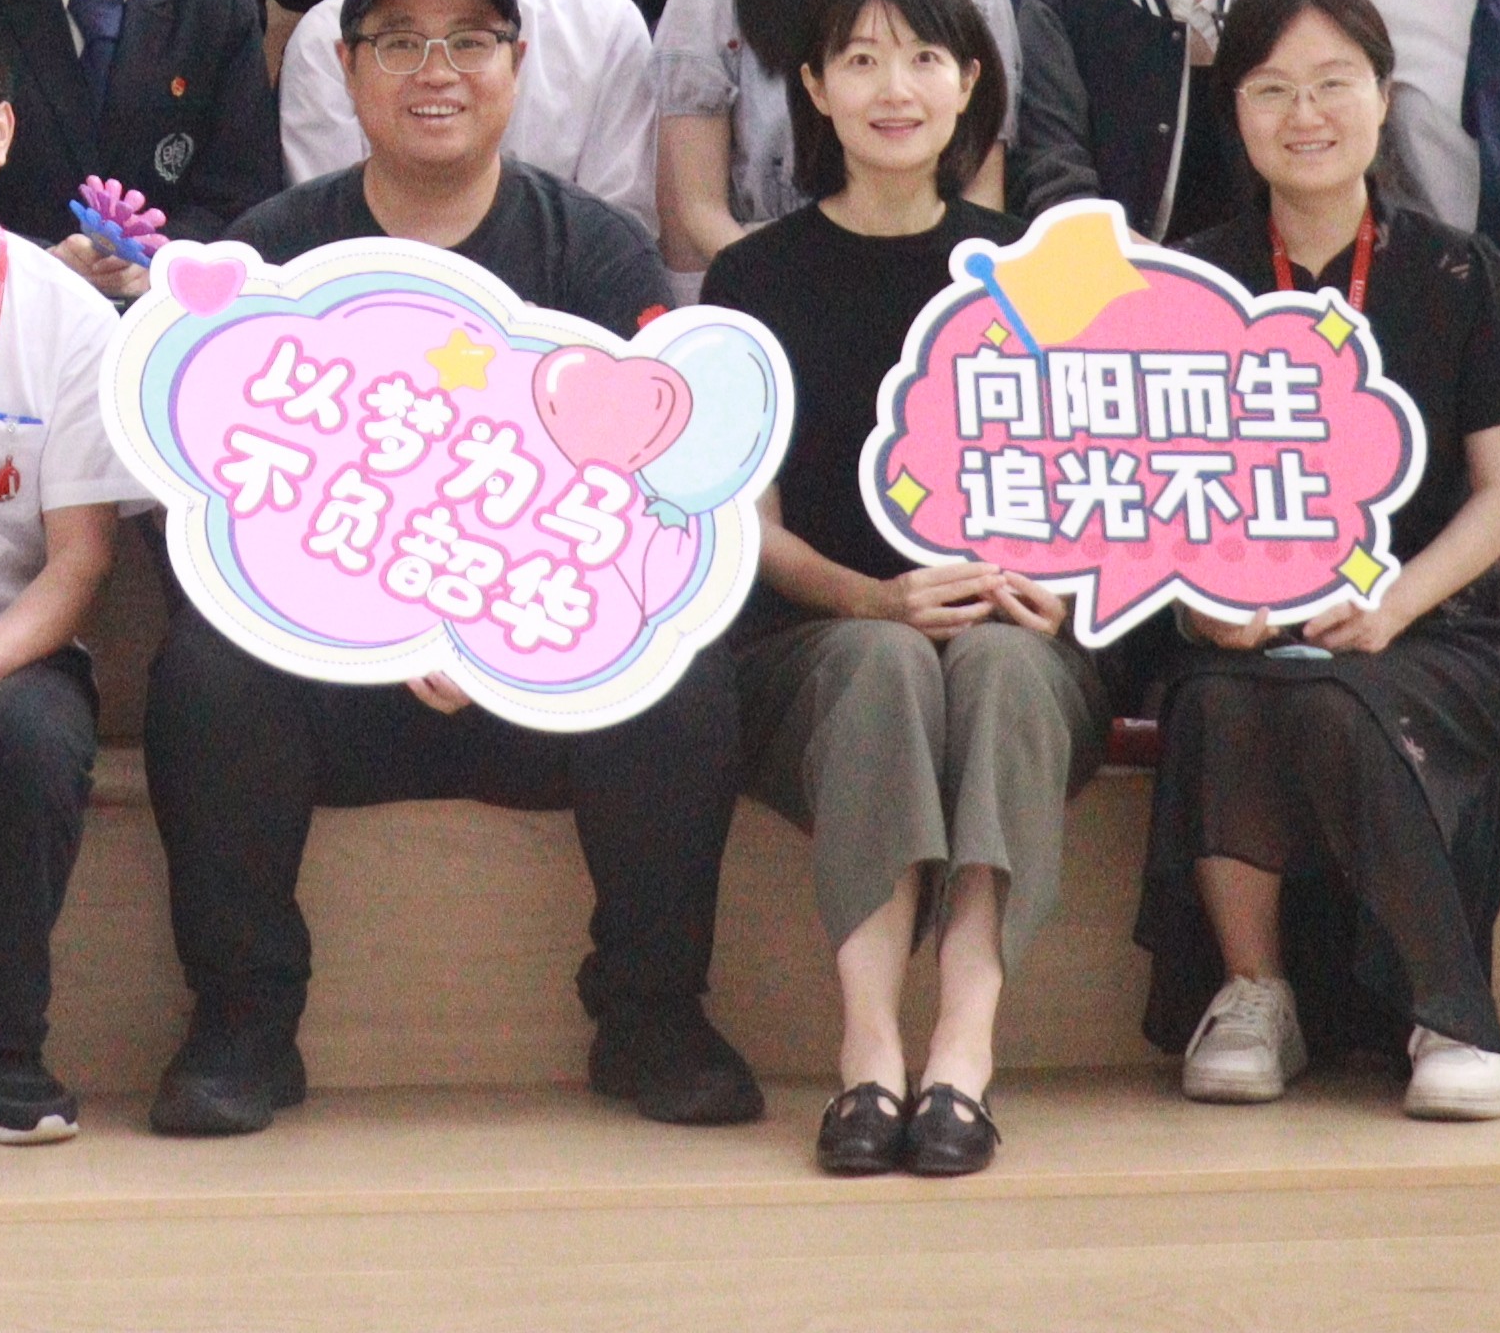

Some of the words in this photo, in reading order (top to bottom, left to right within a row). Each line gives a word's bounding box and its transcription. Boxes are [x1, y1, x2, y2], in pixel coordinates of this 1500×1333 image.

[246, 338, 633, 566] 以梦为马
[954, 347, 1331, 440] 向阳而生
[218, 427, 596, 651] 不负韶华
[960, 447, 1339, 543] 追光不止
